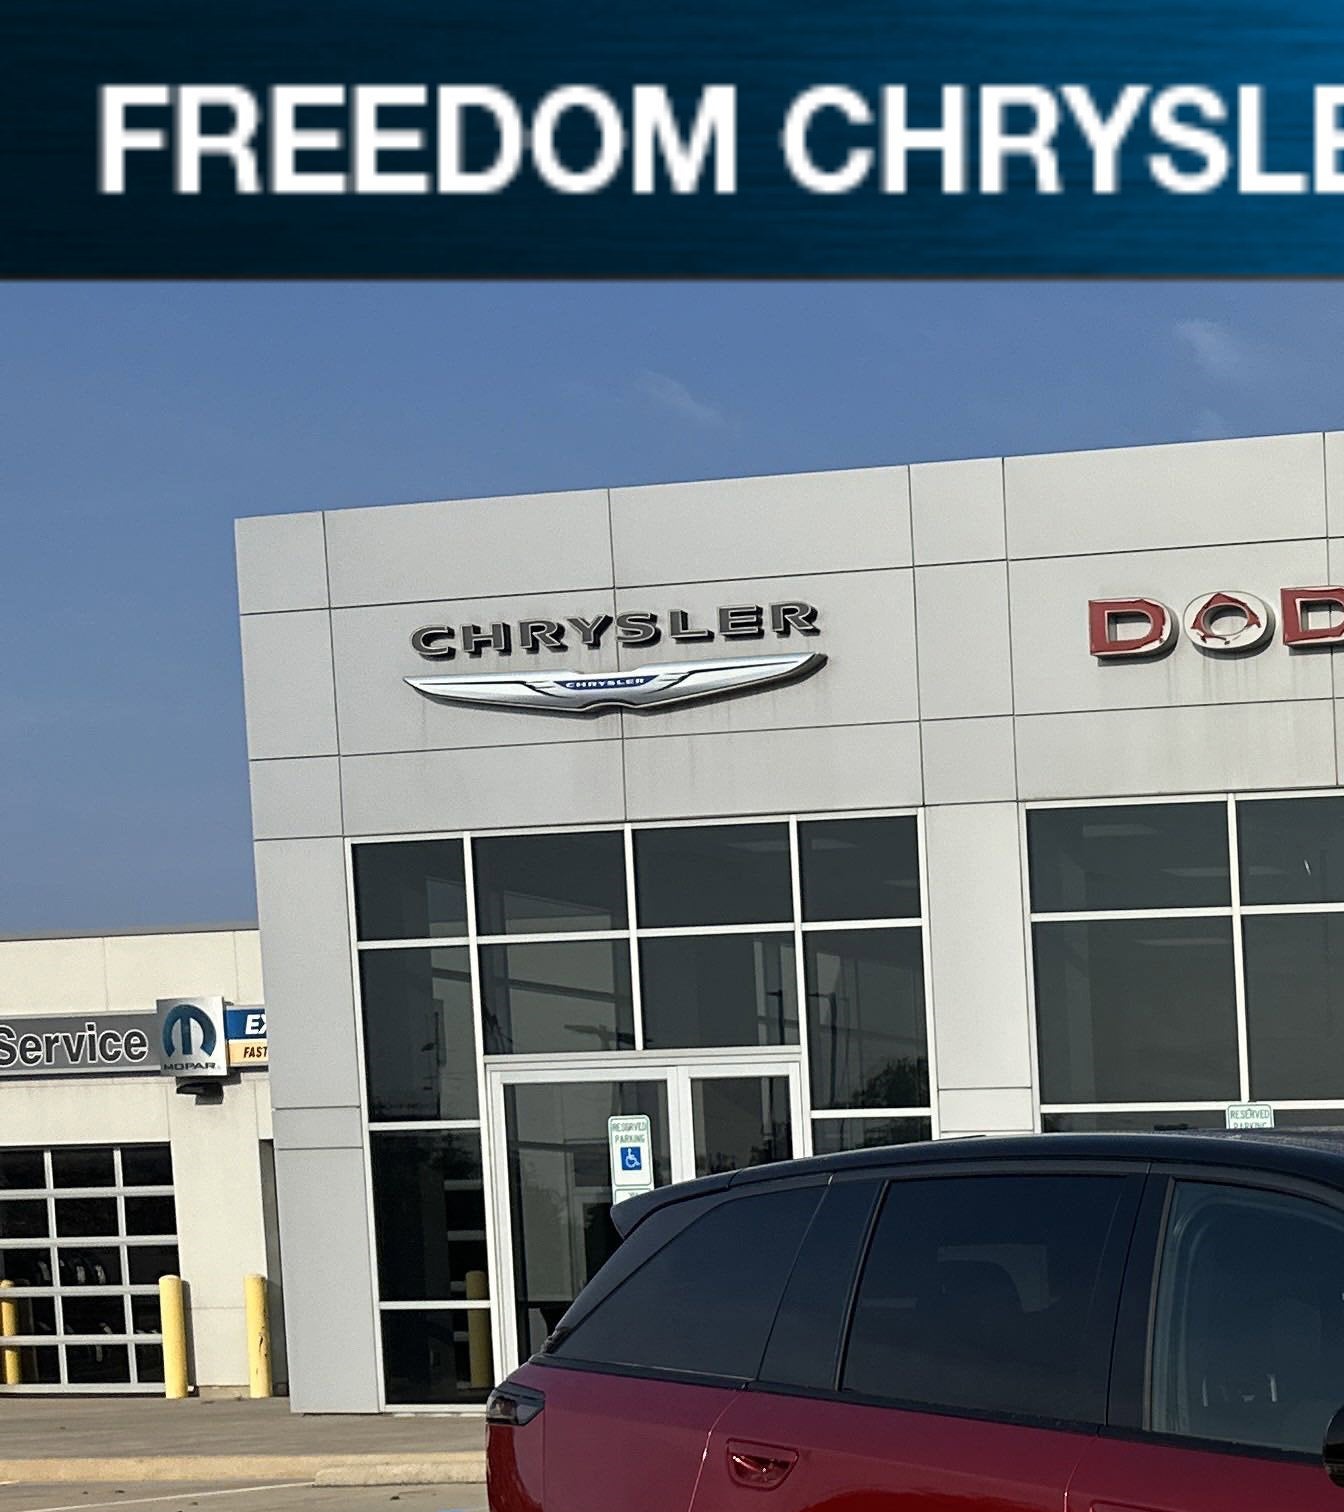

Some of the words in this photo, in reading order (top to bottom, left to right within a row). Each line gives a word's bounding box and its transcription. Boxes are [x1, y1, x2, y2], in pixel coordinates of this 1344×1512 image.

[410, 602, 820, 660] CHRYSLER
[565, 678, 645, 688] CHRYSLER
[0, 1023, 148, 1067] Service
[163, 1062, 217, 1071] MOPAR
[1230, 1109, 1270, 1119] RESERVED
[611, 1122, 647, 1131] RESERVED
[614, 1134, 645, 1143] PARKING
